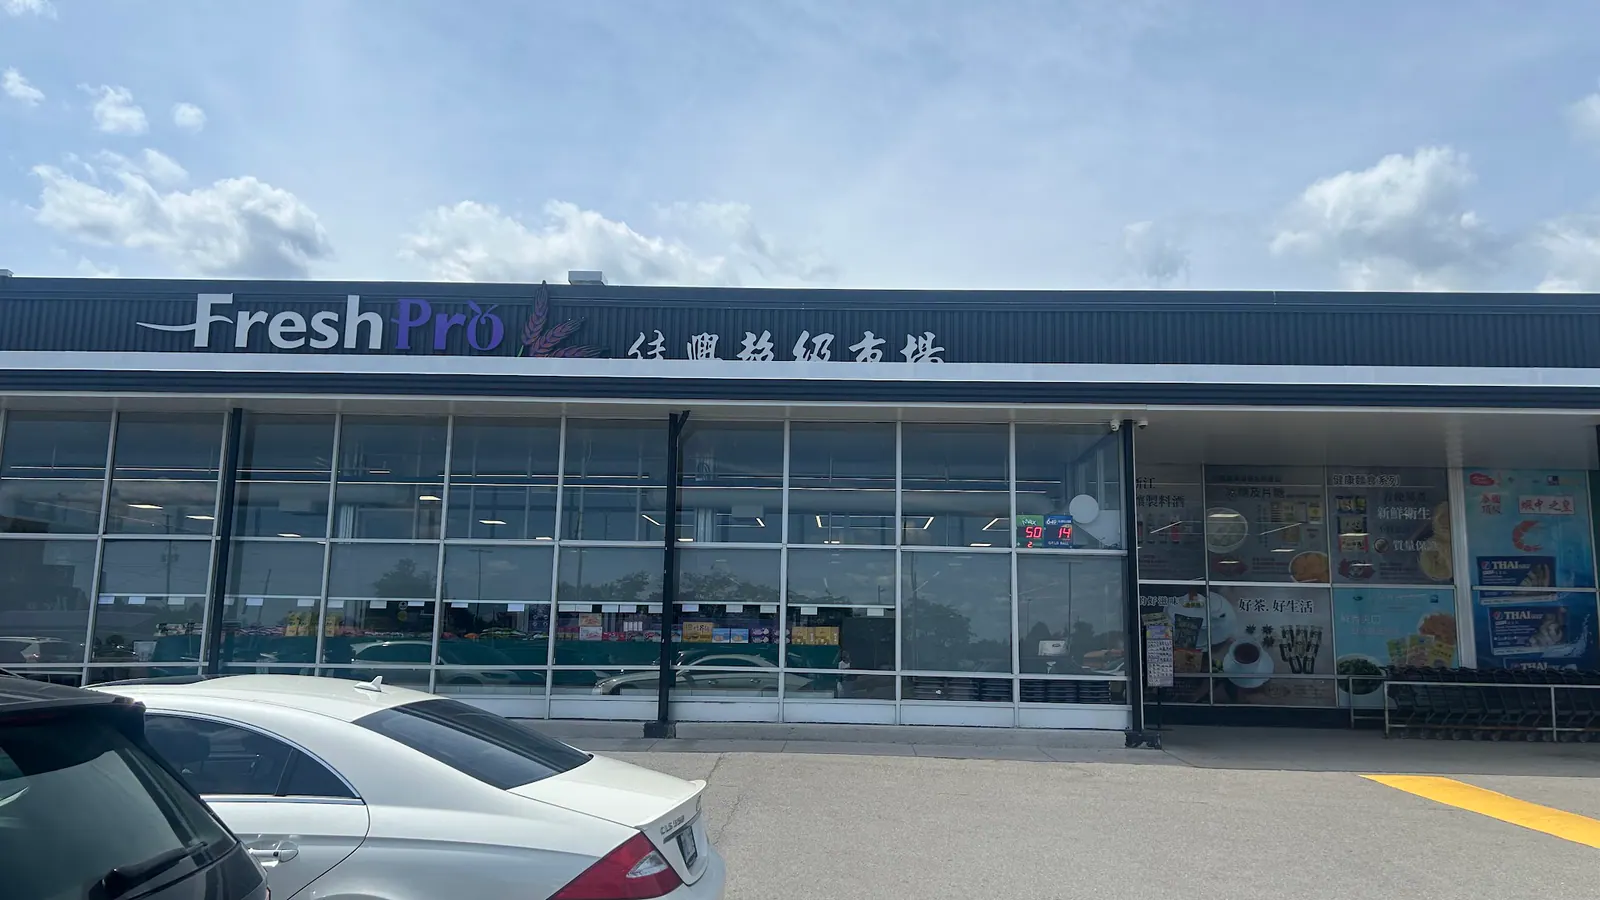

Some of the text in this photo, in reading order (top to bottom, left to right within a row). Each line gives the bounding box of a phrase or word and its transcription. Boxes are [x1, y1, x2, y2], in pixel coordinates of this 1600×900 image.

[137, 293, 505, 351] Fresh Pro
[1025, 526, 1043, 538] 50
[1058, 527, 1071, 538] 14
[1491, 560, 1519, 570] THAI
[1504, 610, 1531, 620] THAI
